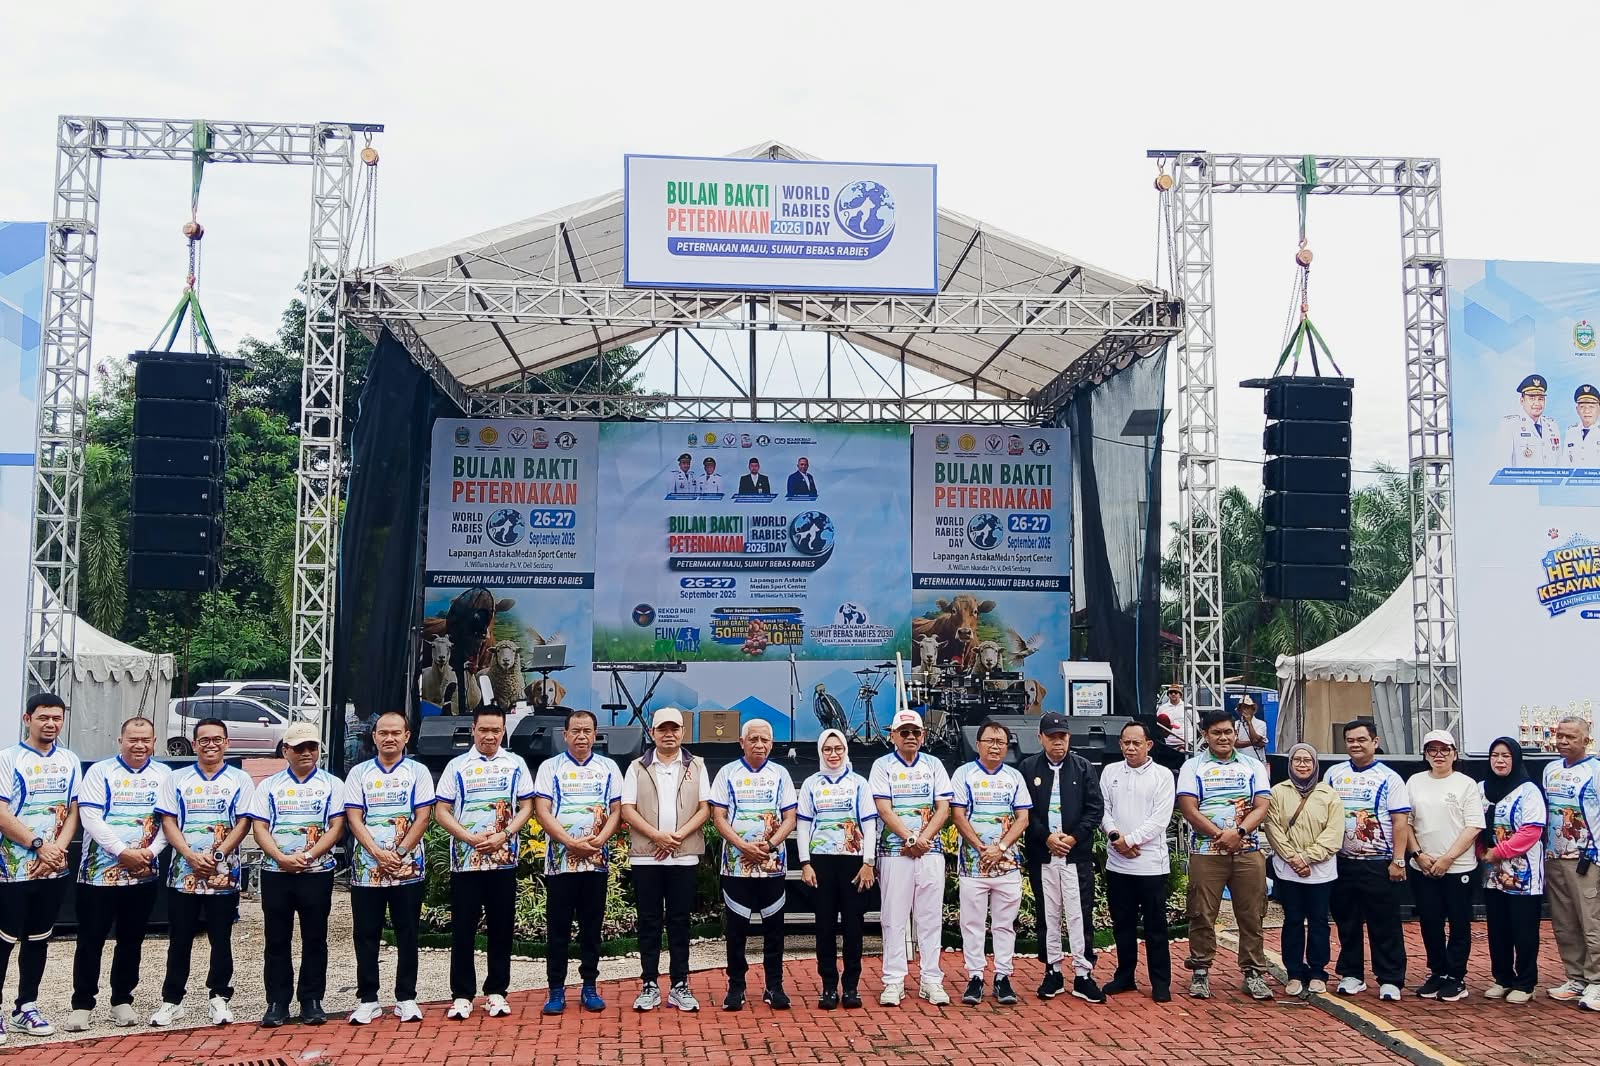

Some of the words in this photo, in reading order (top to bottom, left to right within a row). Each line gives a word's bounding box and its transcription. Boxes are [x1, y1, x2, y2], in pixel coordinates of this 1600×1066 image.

[667, 181, 718, 206] BULAN
[725, 183, 769, 207] BAKTI
[782, 185, 830, 200] WORLD
[782, 203, 830, 218] RABIES
[667, 208, 769, 234] PETERNAKAN
[774, 221, 801, 233] 2026
[804, 221, 830, 235] DAY
[677, 242, 738, 252] PETERNAKAN
[740, 244, 769, 254] MAJU,
[771, 245, 804, 254] SUMUT
[806, 246, 835, 255] BEBAS
[837, 247, 869, 256] RABIES
[453, 456, 515, 479] BULAN
[524, 458, 577, 480] BAKTI
[935, 463, 992, 484] BULAN
[1000, 464, 1052, 485] BAKTI
[452, 481, 577, 505] PETERNAKAN
[935, 487, 1052, 509] PETERNAKAN
[452, 512, 483, 522] WORLD
[534, 512, 572, 526] 26-27
[752, 516, 786, 526] WORLD
[936, 517, 964, 526] WORLD
[452, 524, 482, 533] RABIES
[670, 516, 706, 533] BULAN
[710, 516, 743, 533] BAKTI
[1011, 517, 1046, 530] 26-27
[752, 529, 786, 540] RABIES
[935, 528, 964, 536] RABIES
[466, 535, 482, 545] DAY
[529, 532, 560, 547] September
[562, 533, 575, 545] 2026
[670, 536, 743, 552] PETERNAKAN
[949, 539, 964, 548] DAY
[1008, 536, 1037, 551] September
[746, 543, 766, 552] 2026
[770, 543, 787, 552] DAY
[448, 549, 487, 559] Lapangan
[538, 550, 554, 560] Sport
[556, 550, 576, 559] Center
[933, 552, 968, 562] Lapangan
[1016, 553, 1032, 562] Sport
[1033, 554, 1052, 562] Center
[1554, 546, 1600, 562] KONTE
[434, 575, 482, 584] PETERNAKAN
[483, 576, 505, 584] MAJU,
[506, 576, 532, 584] SUMUT
[558, 576, 583, 584] RABIES
[686, 579, 731, 587] 26-27
[965, 578, 986, 586] MAJU,
[680, 591, 718, 600] September
[655, 628, 675, 639] FUN
[716, 628, 731, 638] 50
[767, 632, 783, 644] 10
[675, 640, 700, 652] WALK
